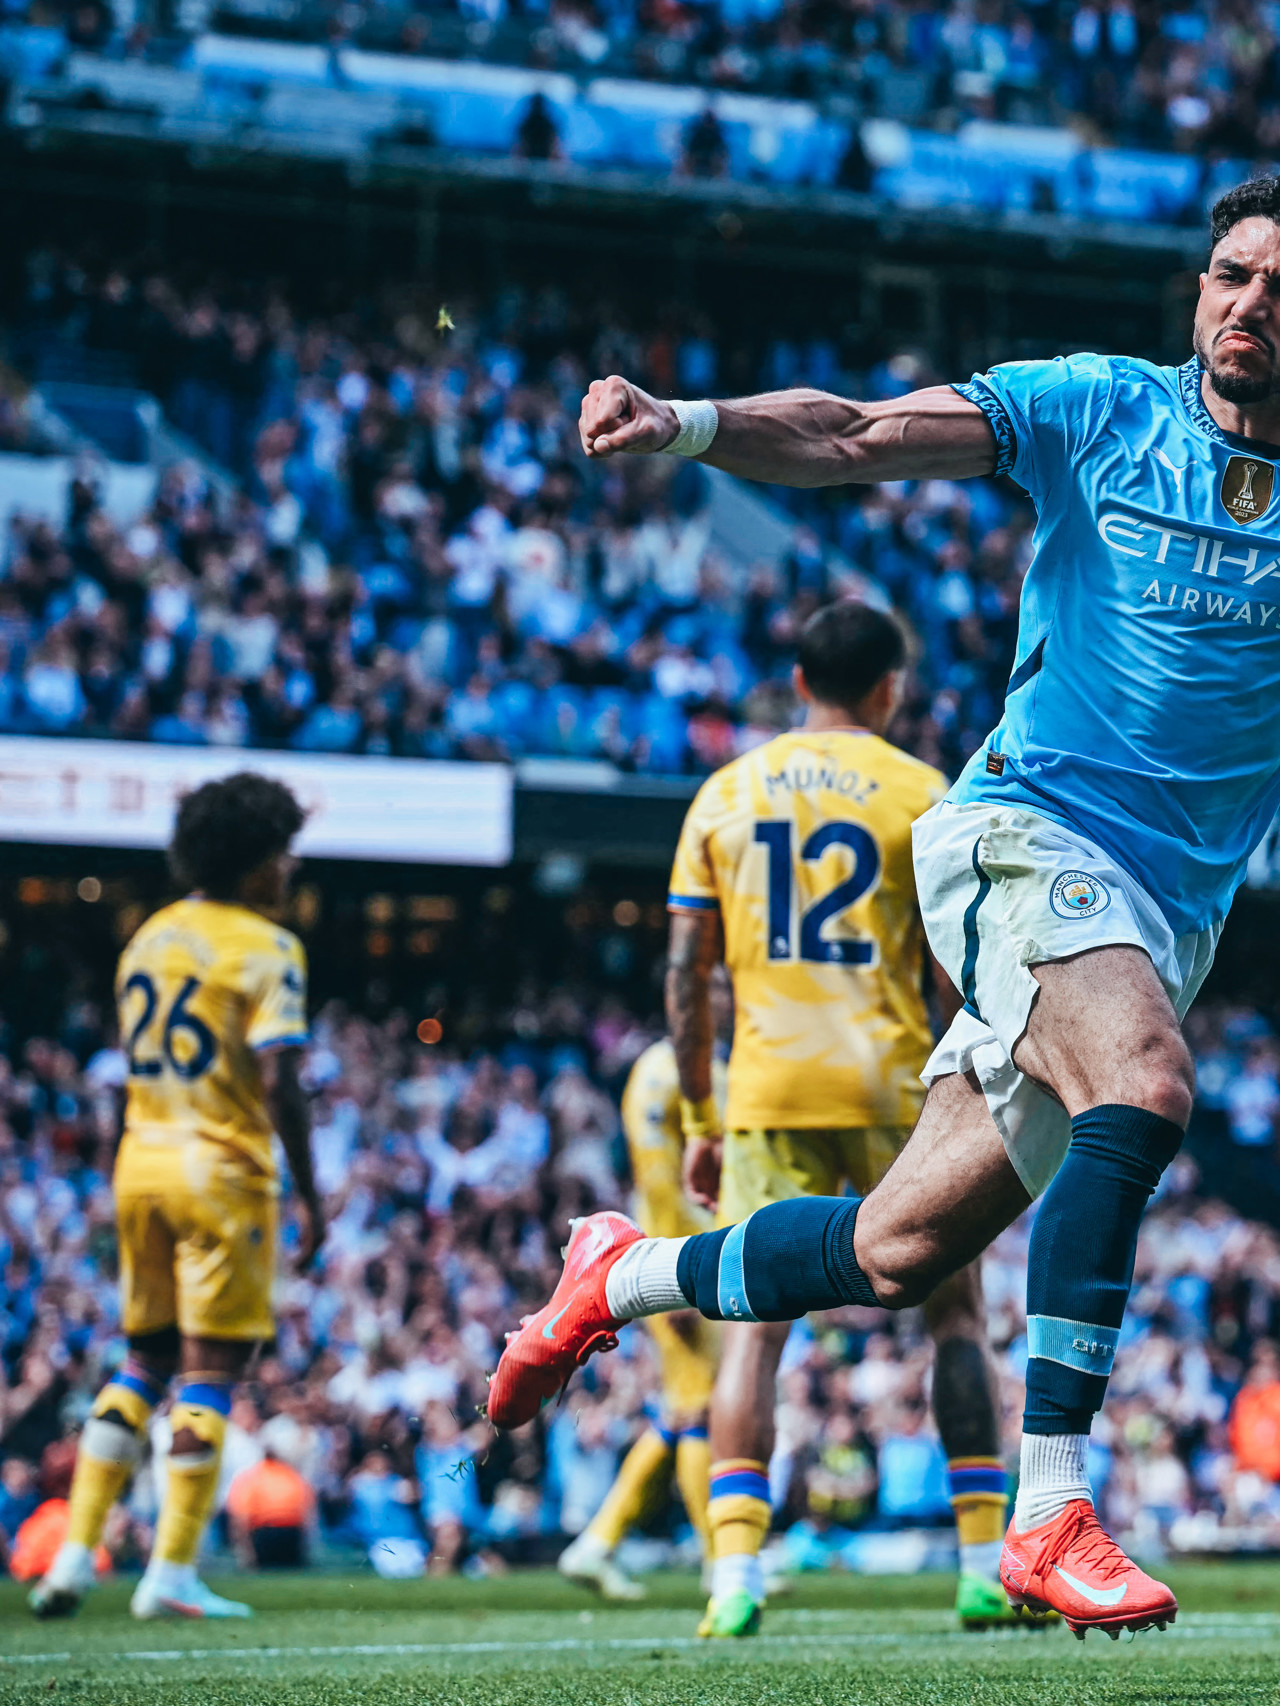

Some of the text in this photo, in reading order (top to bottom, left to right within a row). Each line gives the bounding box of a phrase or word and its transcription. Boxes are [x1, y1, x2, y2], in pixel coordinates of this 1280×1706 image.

[1232, 498, 1255, 511] FIFA
[754, 819, 879, 964] 12
[1079, 907, 1097, 917] CITY
[126, 970, 218, 1079] 26
